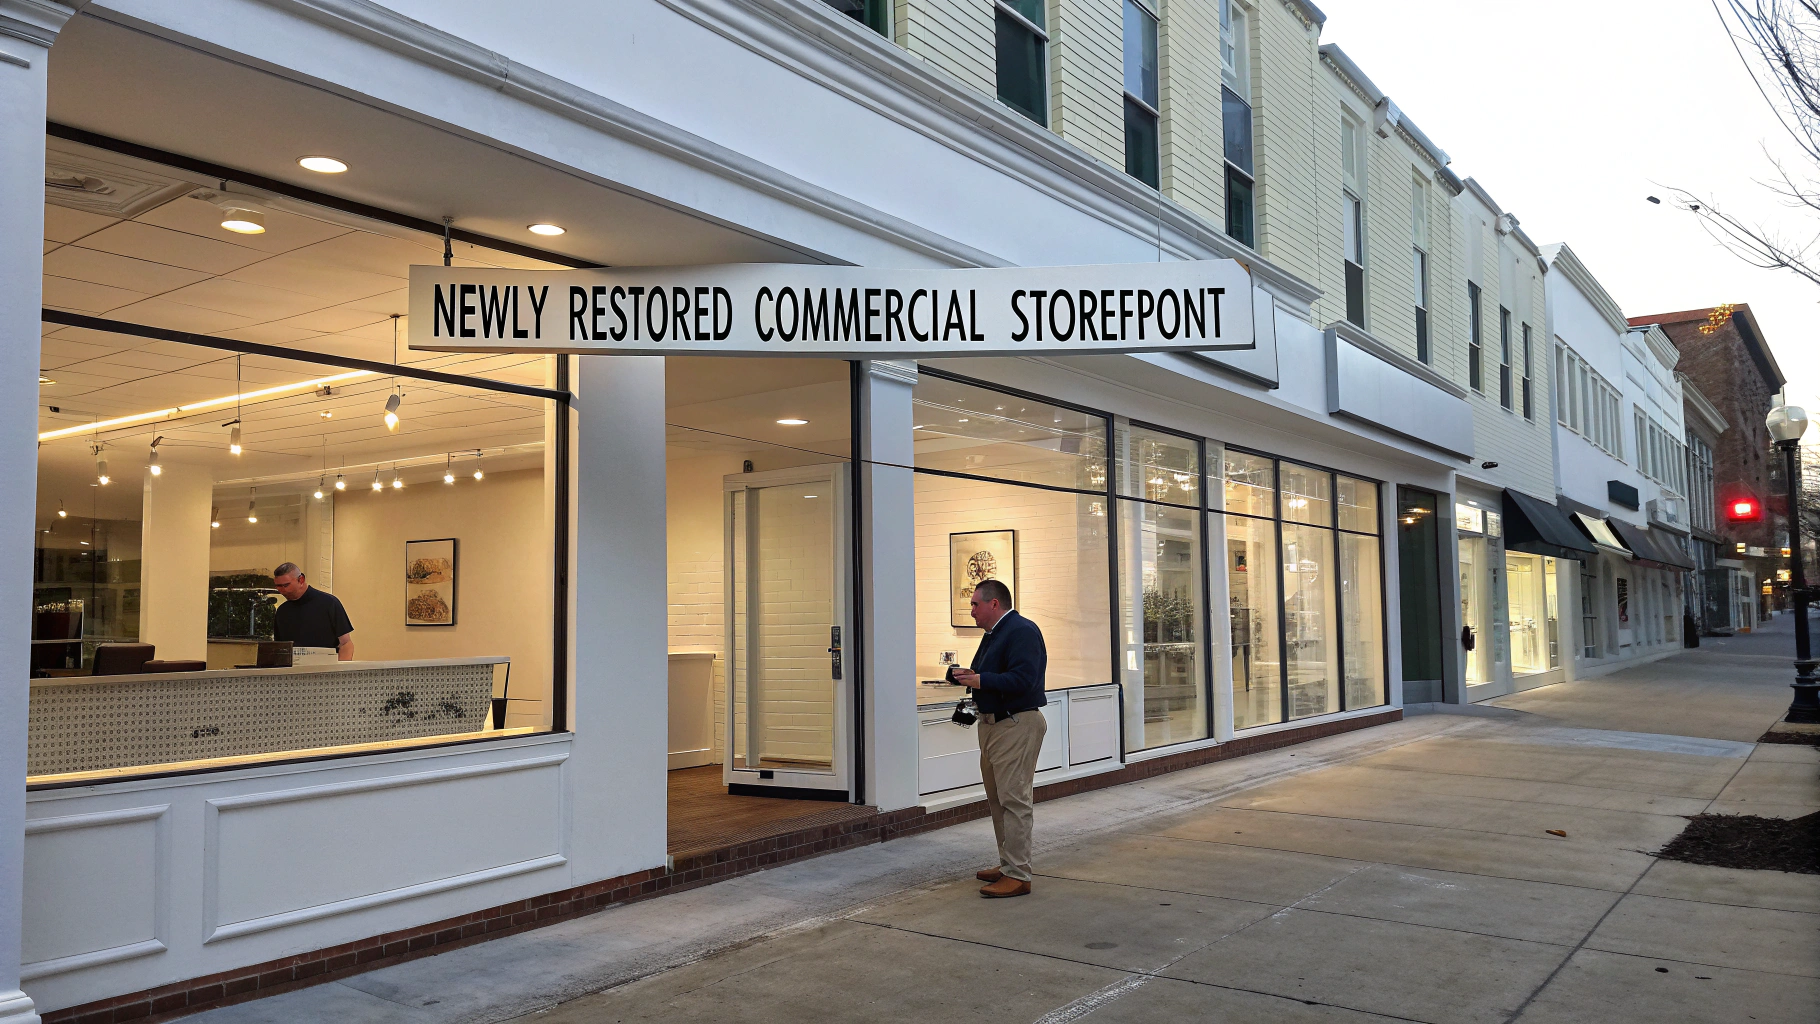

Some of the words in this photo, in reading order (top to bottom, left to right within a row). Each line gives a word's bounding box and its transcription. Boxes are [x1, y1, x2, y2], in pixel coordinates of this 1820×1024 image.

[433, 283, 549, 339] NEWLY
[569, 285, 733, 343] RESTORED
[754, 286, 985, 342] COMMERCIAL
[1010, 287, 1226, 342] STOREFPONT
